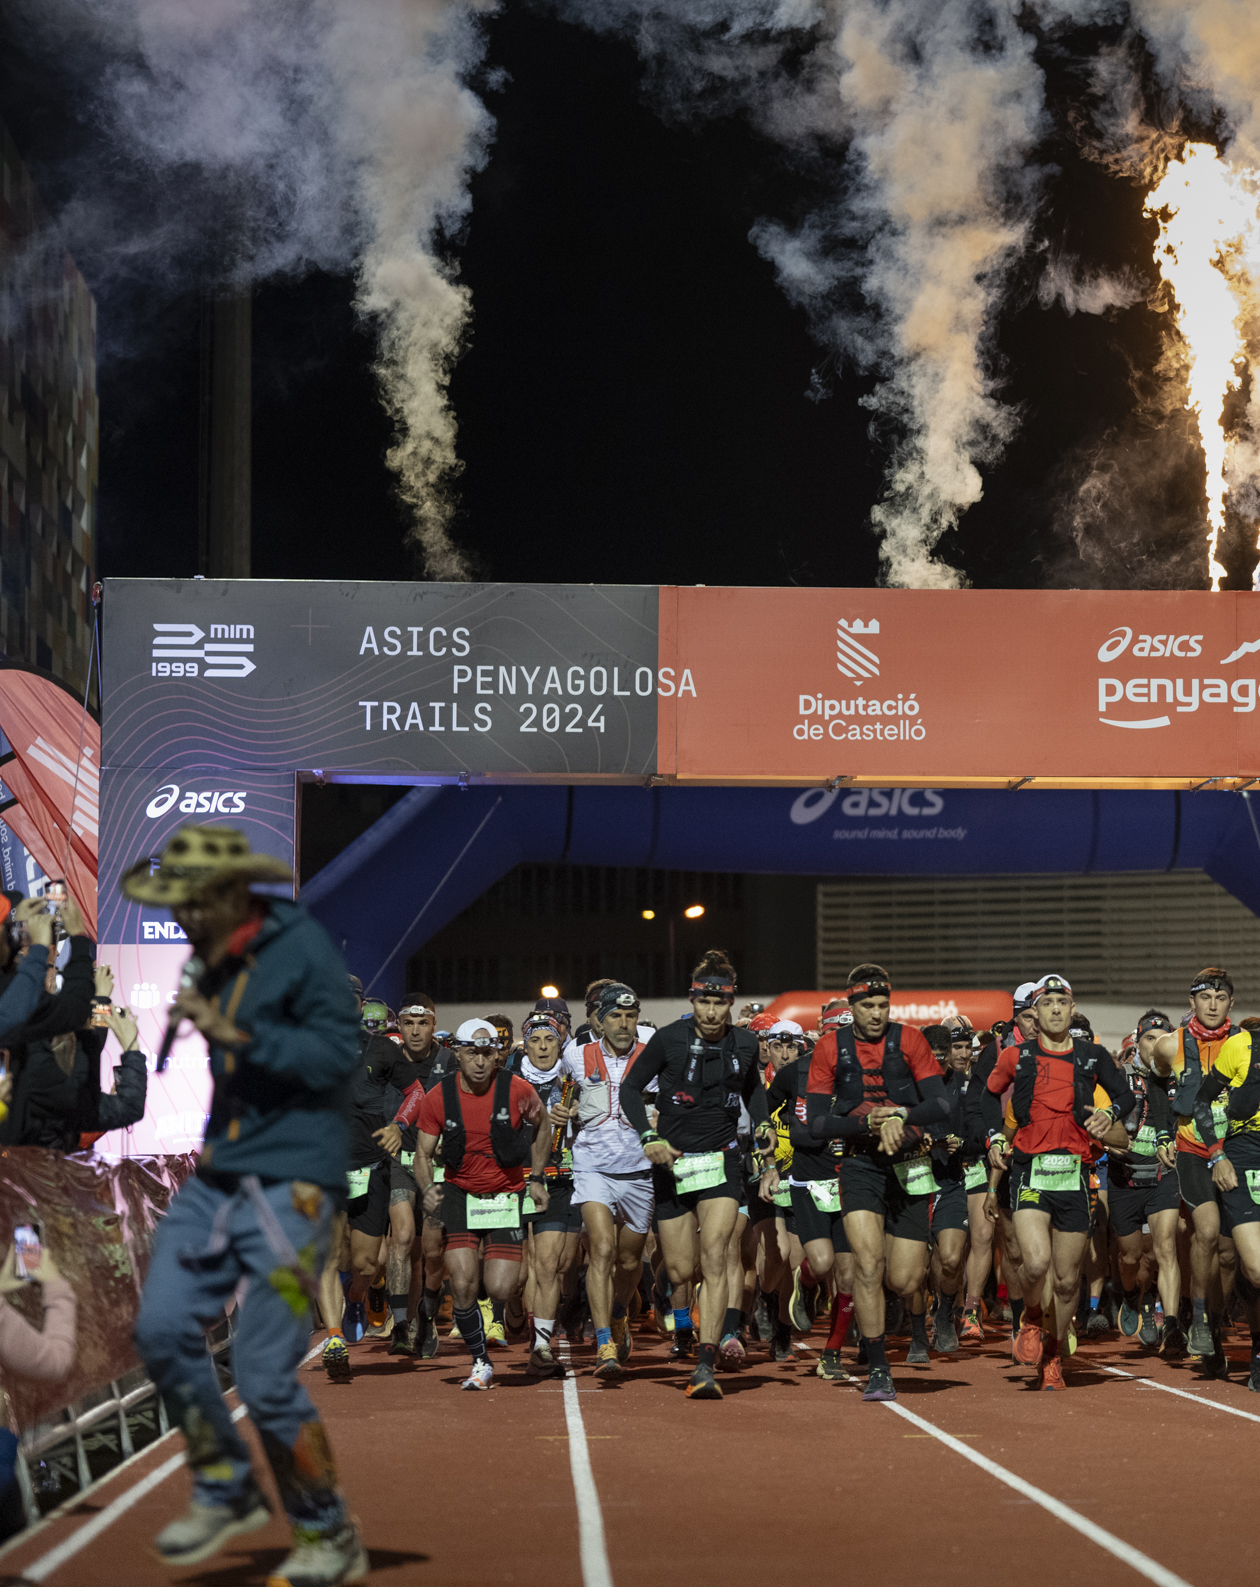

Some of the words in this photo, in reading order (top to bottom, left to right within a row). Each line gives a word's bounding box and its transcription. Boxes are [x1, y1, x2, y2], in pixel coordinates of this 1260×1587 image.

[360, 627, 471, 657] ASICS
[1132, 635, 1204, 657] asics
[152, 663, 199, 677] 1999
[453, 665, 698, 698] PENYAGOLOSA
[359, 701, 493, 732] TRAILS
[519, 704, 606, 733] 2024
[798, 693, 920, 719] Diputació
[793, 720, 824, 741] de
[828, 719, 926, 741] Castelló
[179, 791, 247, 813] asics
[833, 827, 869, 840] sound
[901, 827, 936, 840] sound
[937, 826, 967, 841] body
[1043, 1155, 1071, 1166] 2020
